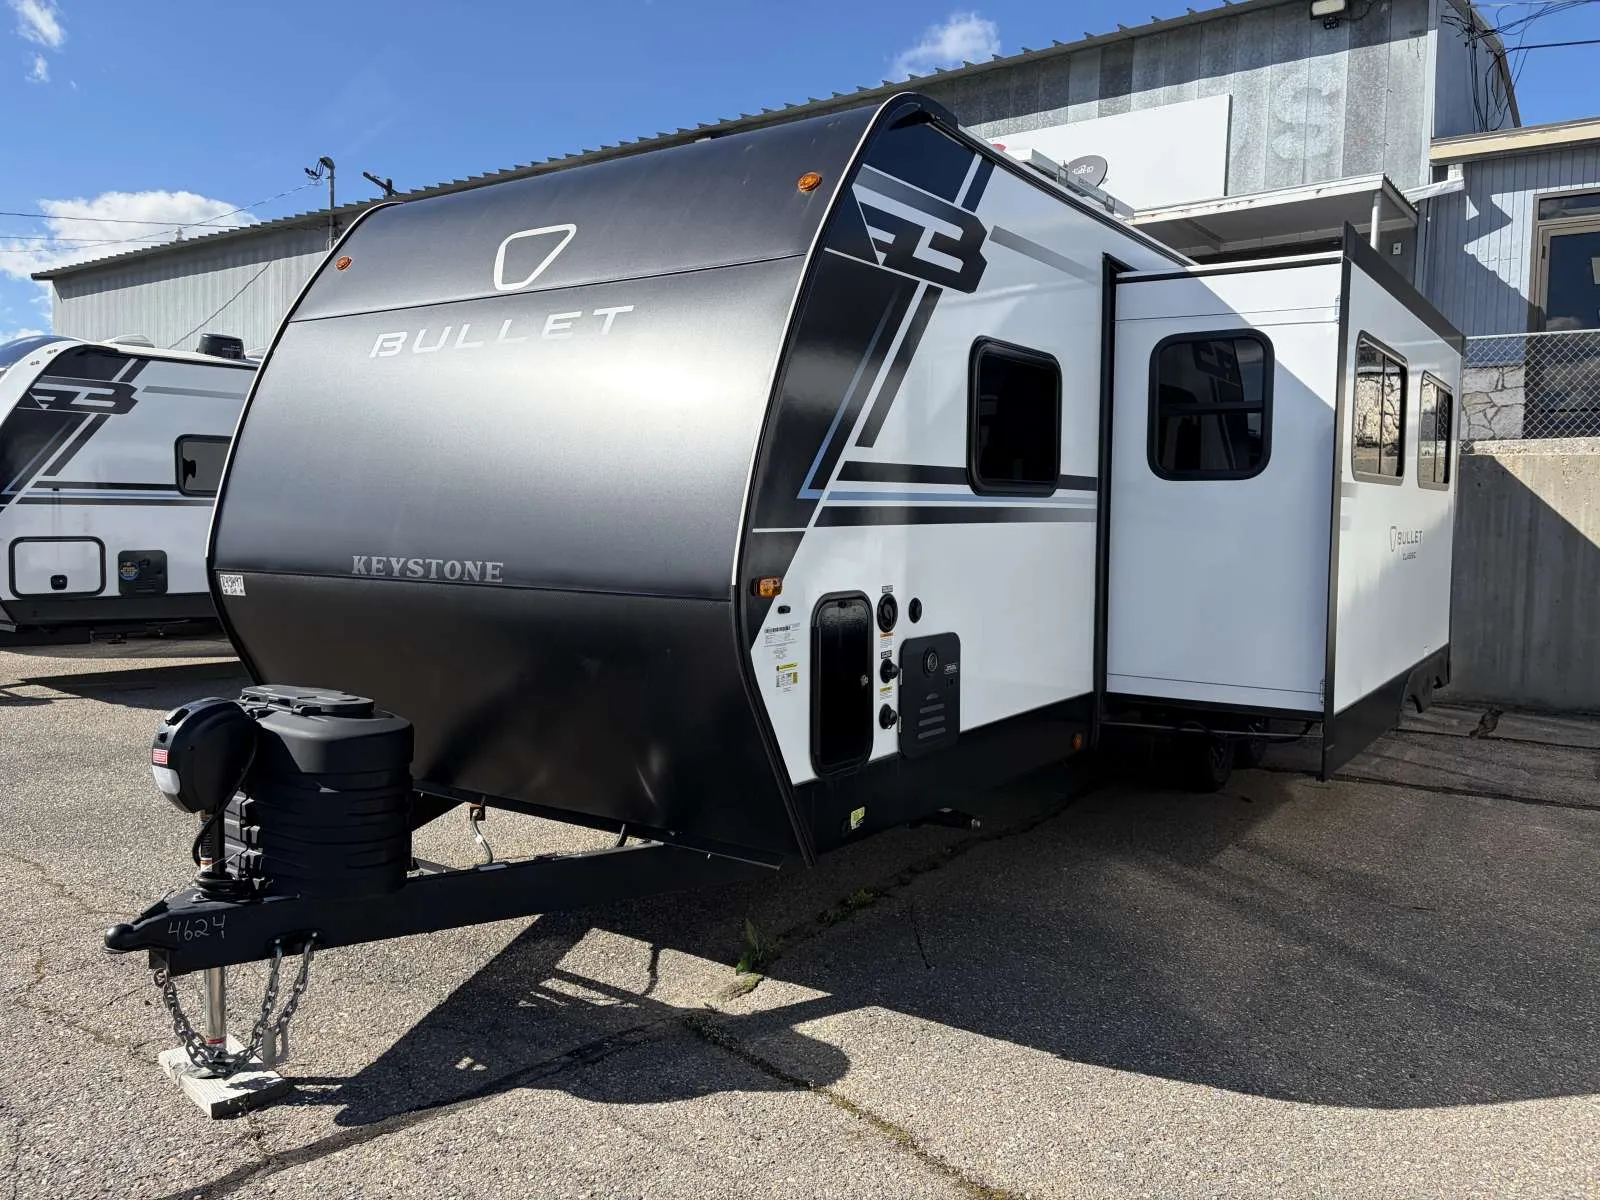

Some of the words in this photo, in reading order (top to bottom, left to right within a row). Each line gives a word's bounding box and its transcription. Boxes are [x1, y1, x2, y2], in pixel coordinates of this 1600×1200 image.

[370, 304, 634, 358] BULLET
[1397, 530, 1423, 546] BULLET
[351, 555, 505, 583] KEYSTONE
[167, 914, 227, 942] 4624
